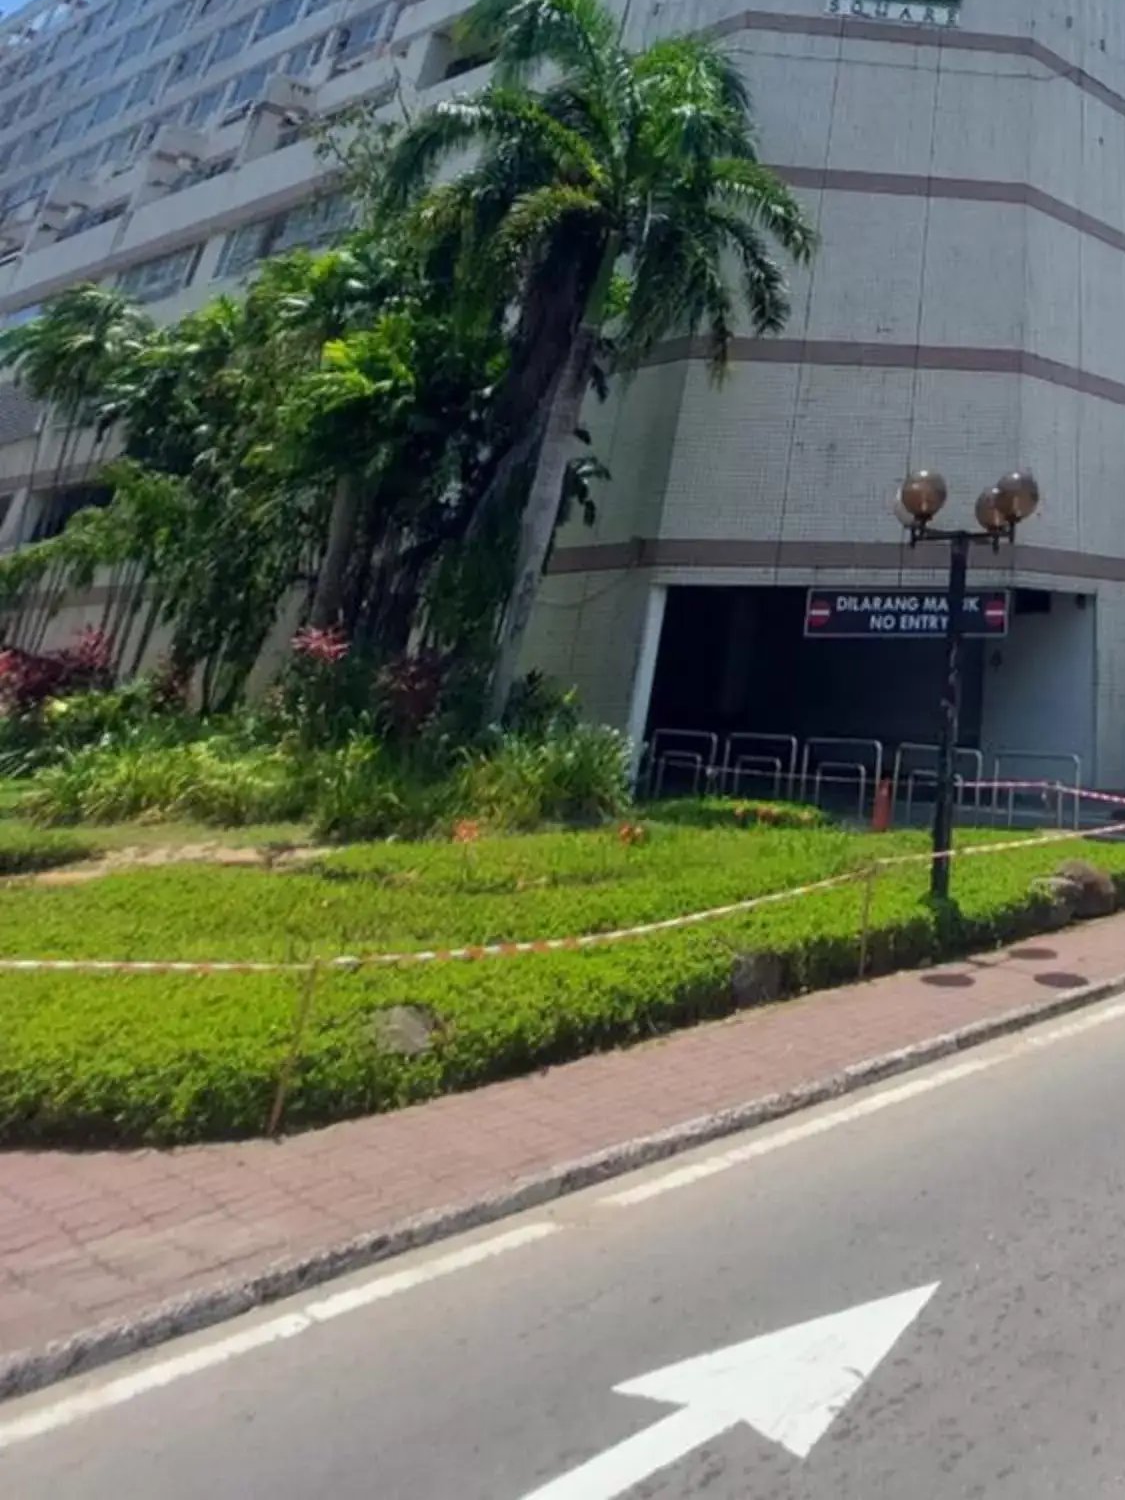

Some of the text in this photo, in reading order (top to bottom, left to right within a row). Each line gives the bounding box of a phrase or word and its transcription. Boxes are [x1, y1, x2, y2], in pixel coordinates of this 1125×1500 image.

[836, 596, 918, 611] DILARANG
[869, 615, 949, 630] NO ENTRY
